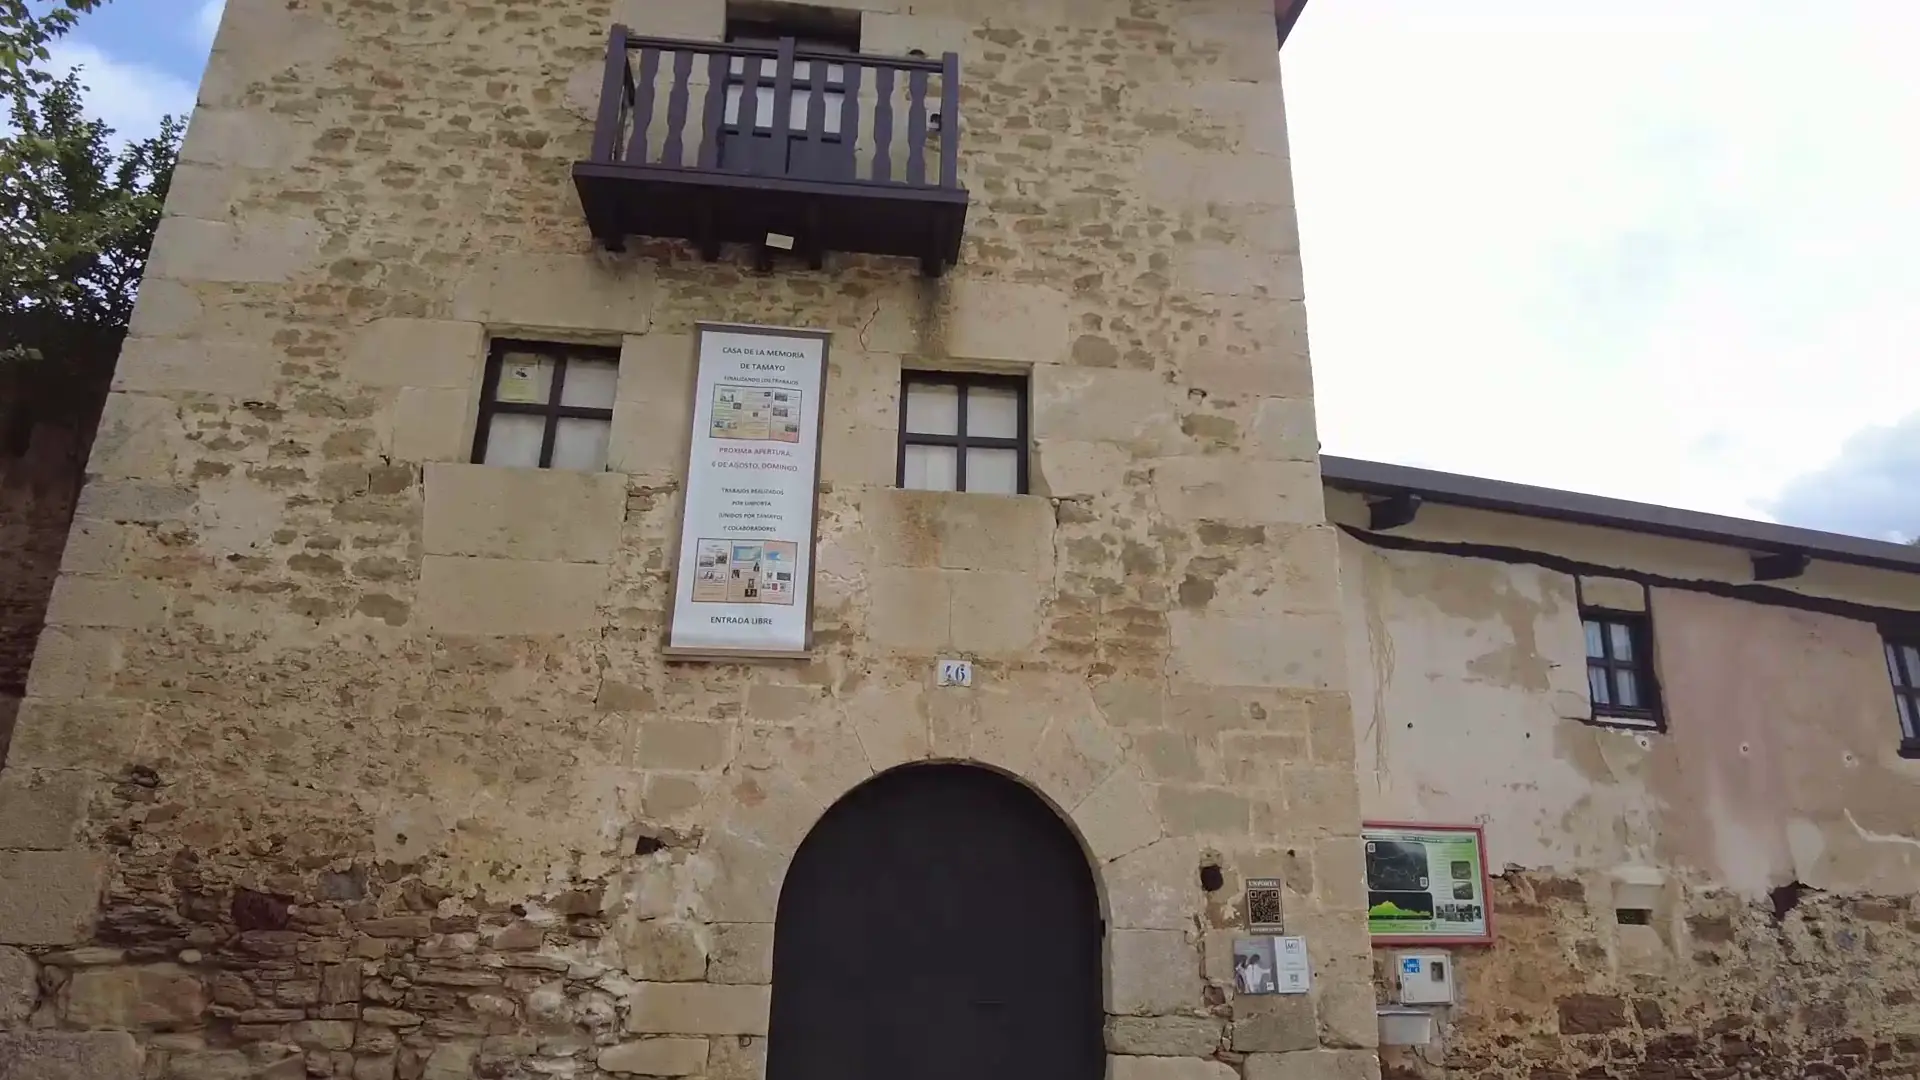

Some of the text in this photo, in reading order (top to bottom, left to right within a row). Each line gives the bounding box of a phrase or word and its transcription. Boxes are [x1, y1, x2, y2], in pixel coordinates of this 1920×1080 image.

[766, 350, 805, 358] MEMORIA
[752, 363, 785, 371] TAMAYO
[761, 463, 798, 472] DOMINGO
[710, 616, 773, 625] ENTRADA LIBRE
